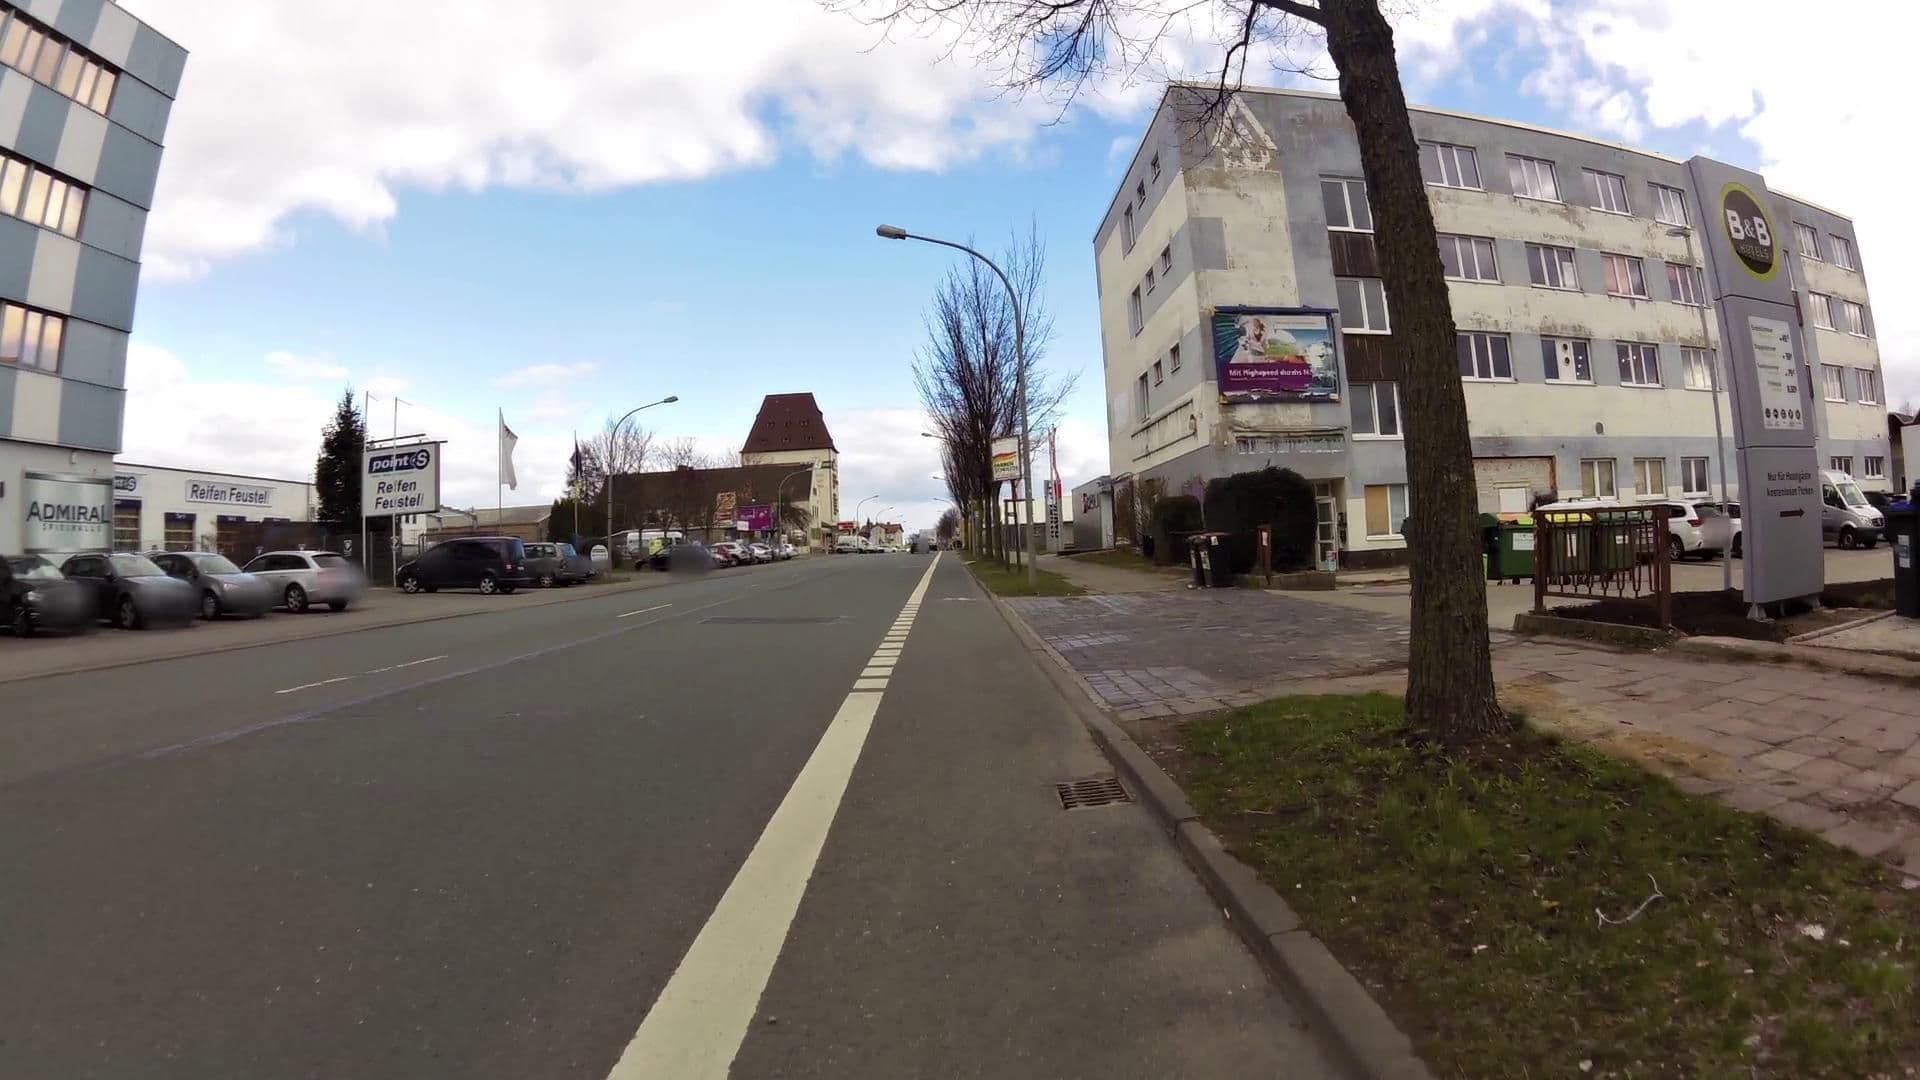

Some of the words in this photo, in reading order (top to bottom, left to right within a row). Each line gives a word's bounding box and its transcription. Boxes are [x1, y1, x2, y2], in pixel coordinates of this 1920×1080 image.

[1726, 208, 1771, 246] B&B
[1229, 368, 1241, 377] Mit
[372, 455, 409, 471] point
[190, 483, 226, 500] Reifen
[229, 487, 268, 504] Feustel
